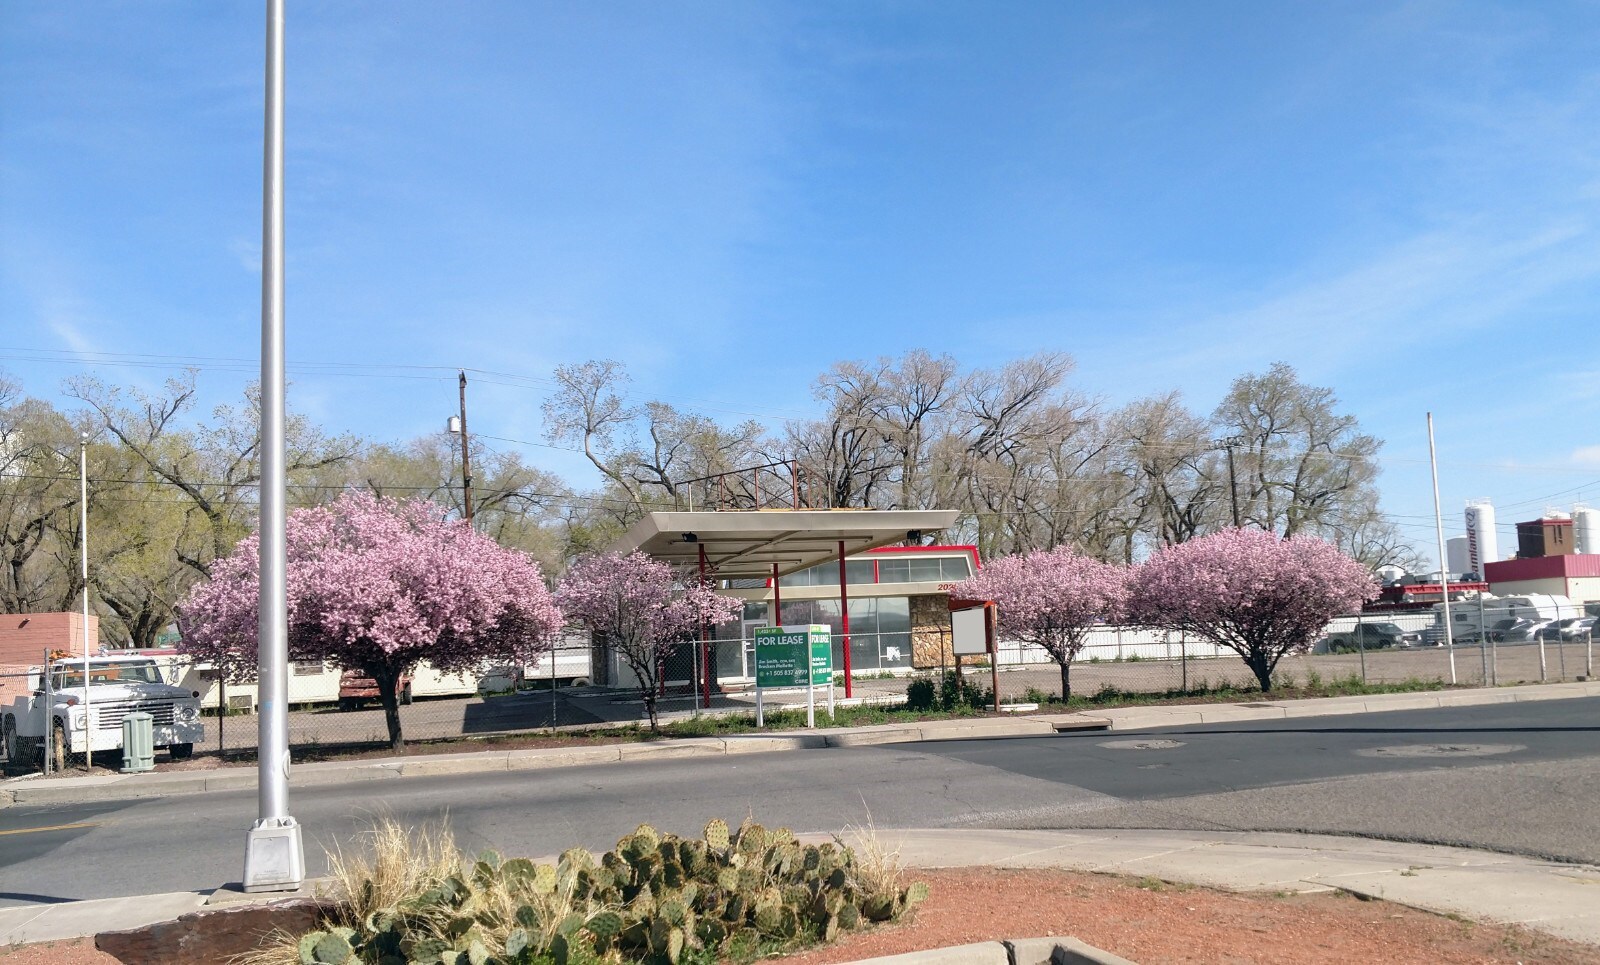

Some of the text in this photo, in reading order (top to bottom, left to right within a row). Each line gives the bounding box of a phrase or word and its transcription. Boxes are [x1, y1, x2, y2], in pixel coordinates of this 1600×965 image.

[1467, 528, 1479, 573] amland
[757, 635, 804, 646] FOR LEASE
